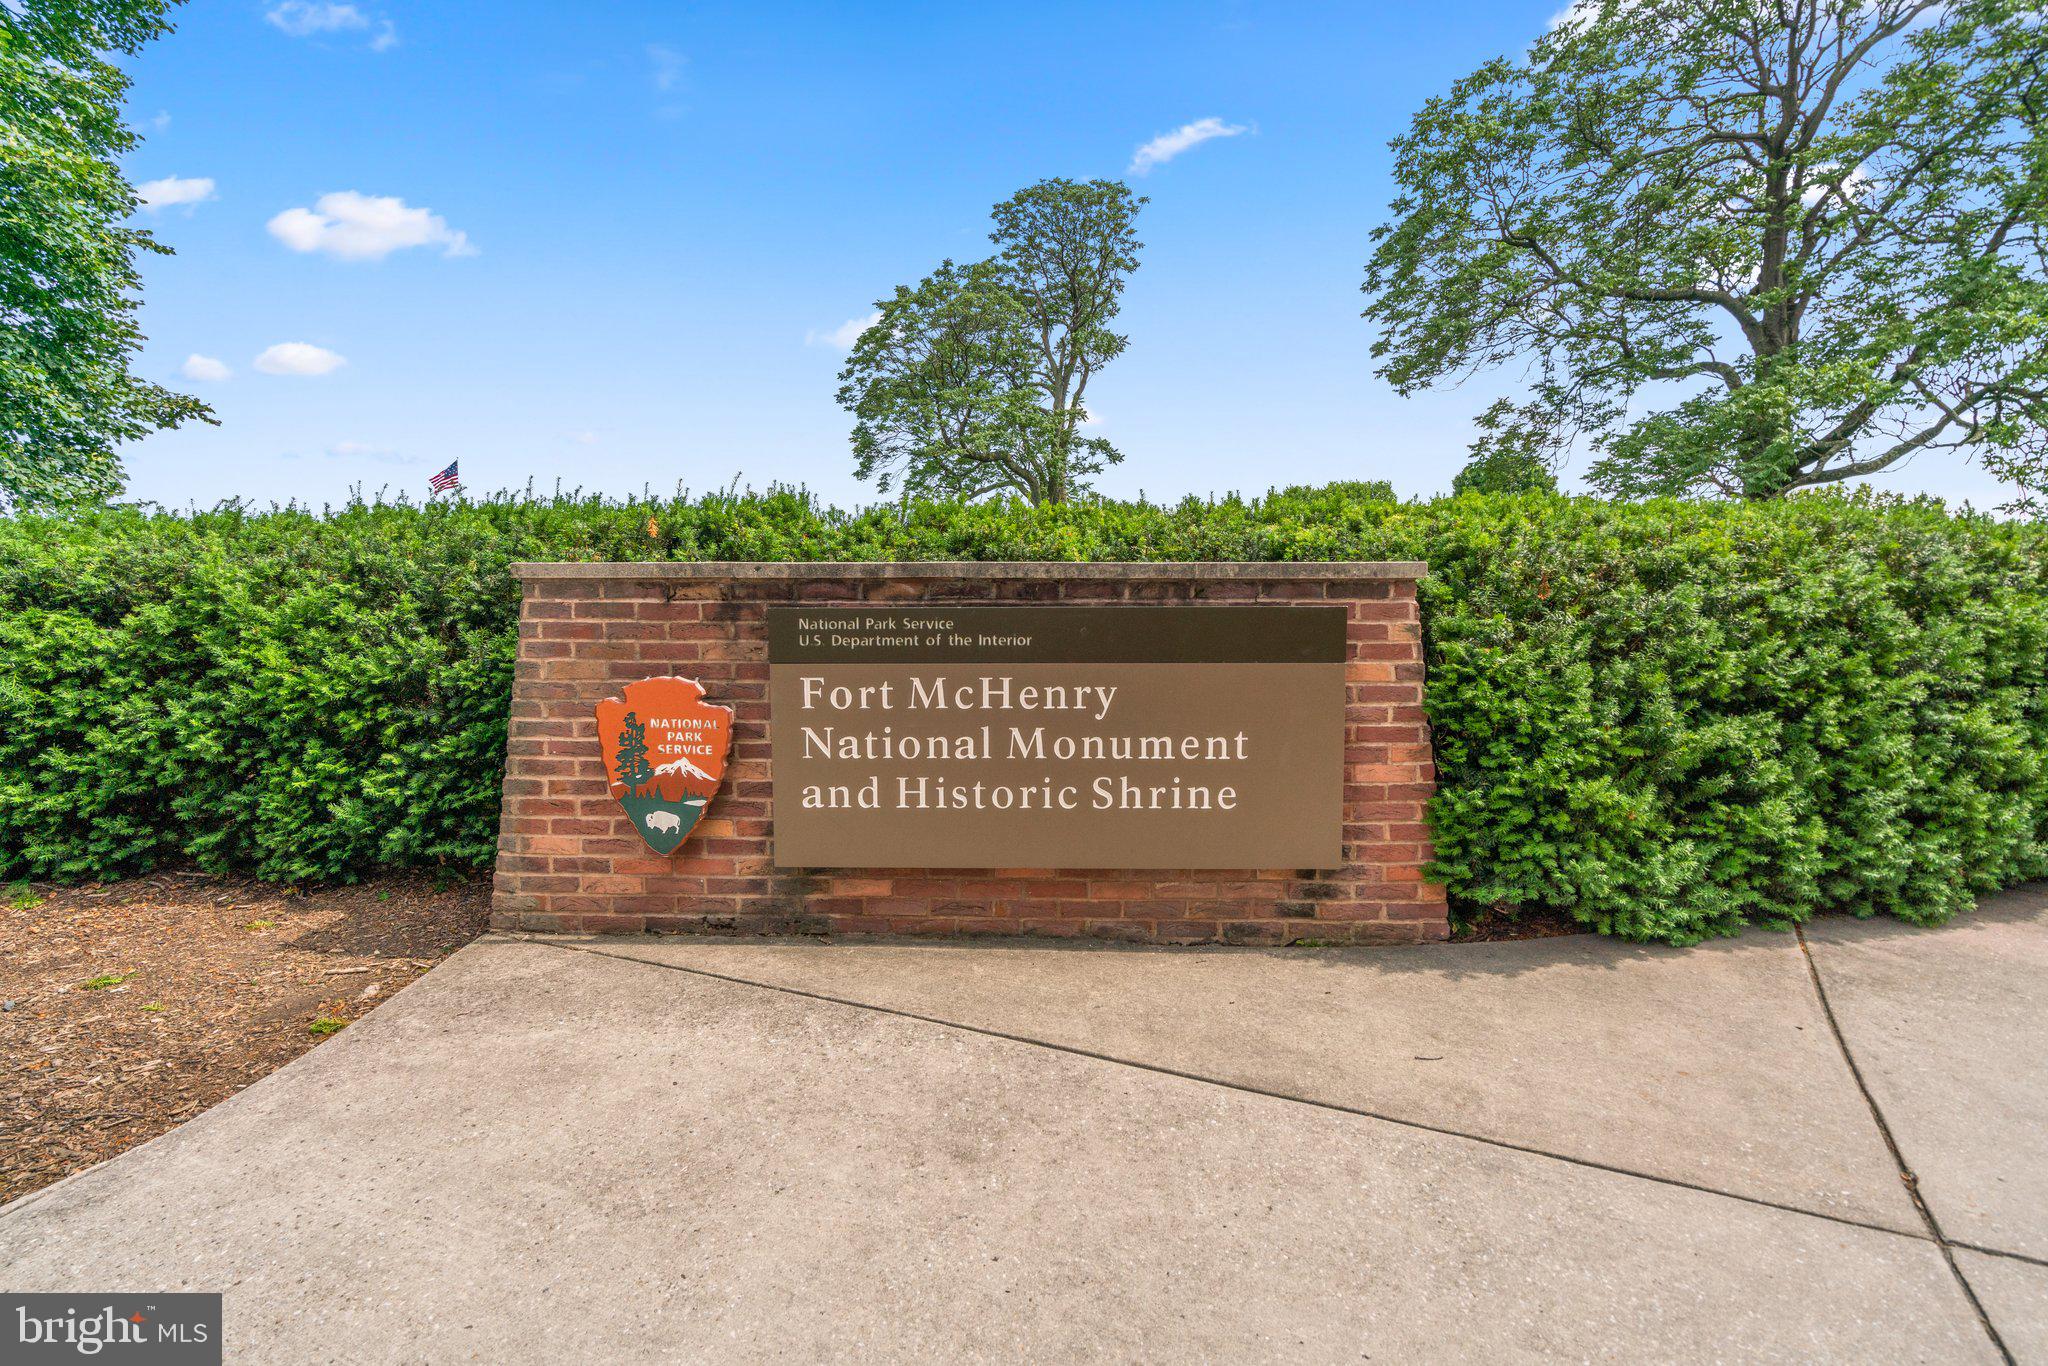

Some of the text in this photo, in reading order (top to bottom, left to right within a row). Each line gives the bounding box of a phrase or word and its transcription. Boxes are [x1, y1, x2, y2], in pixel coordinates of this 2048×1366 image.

[798, 616, 954, 630] National Park Service
[831, 634, 919, 650] Department
[925, 633, 942, 646] of
[947, 633, 973, 646] the
[978, 634, 1032, 647] Interior
[799, 677, 1118, 721] Fort McHenry
[649, 718, 720, 730] NATIONAL
[667, 731, 703, 742] PARK
[800, 725, 1249, 760] National Monument
[657, 744, 713, 755] SERVICE
[801, 775, 1237, 810] and Historic Shrine
